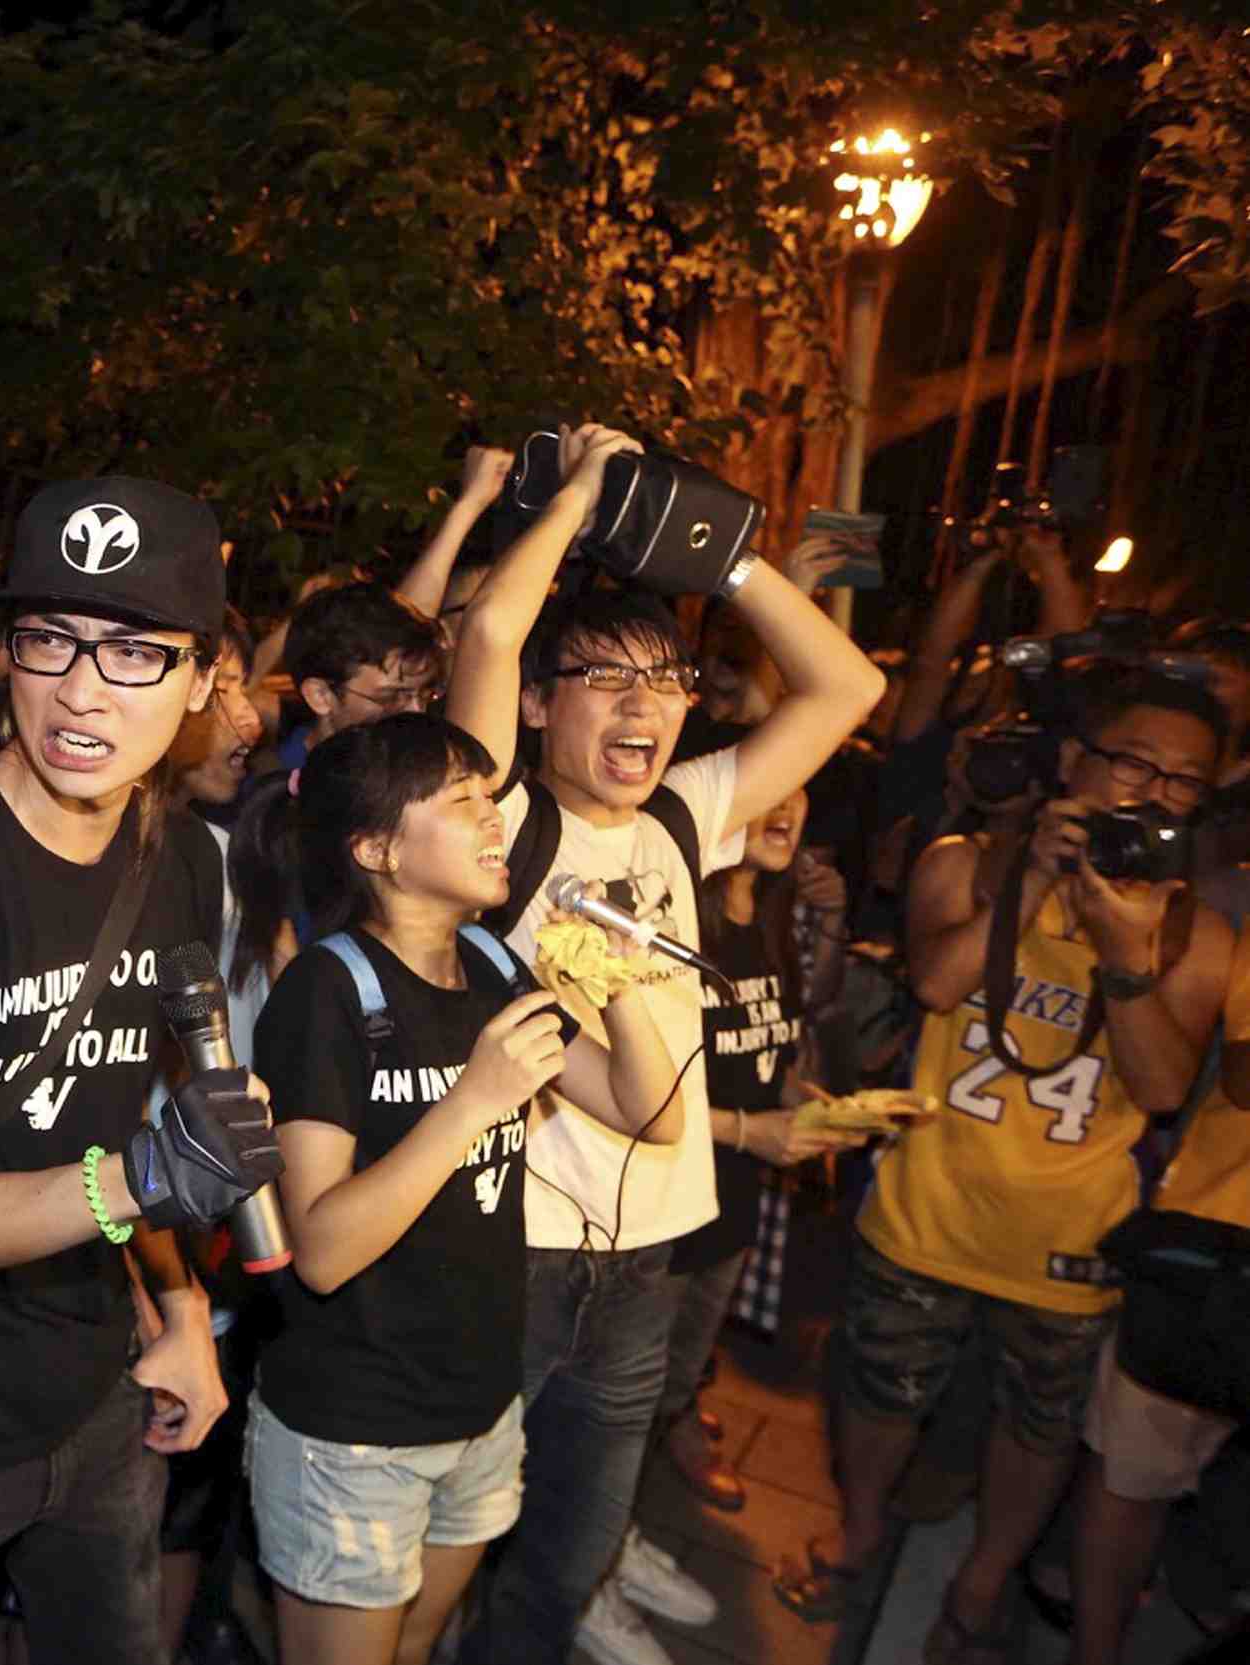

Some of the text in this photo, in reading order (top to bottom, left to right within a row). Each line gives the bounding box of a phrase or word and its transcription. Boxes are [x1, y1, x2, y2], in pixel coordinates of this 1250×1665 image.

[22, 960, 90, 1017] INJUR
[105, 1026, 150, 1065] ALL
[370, 1068, 415, 1103] AN
[946, 1018, 1104, 1146] 24
[500, 1119, 525, 1157] TO
